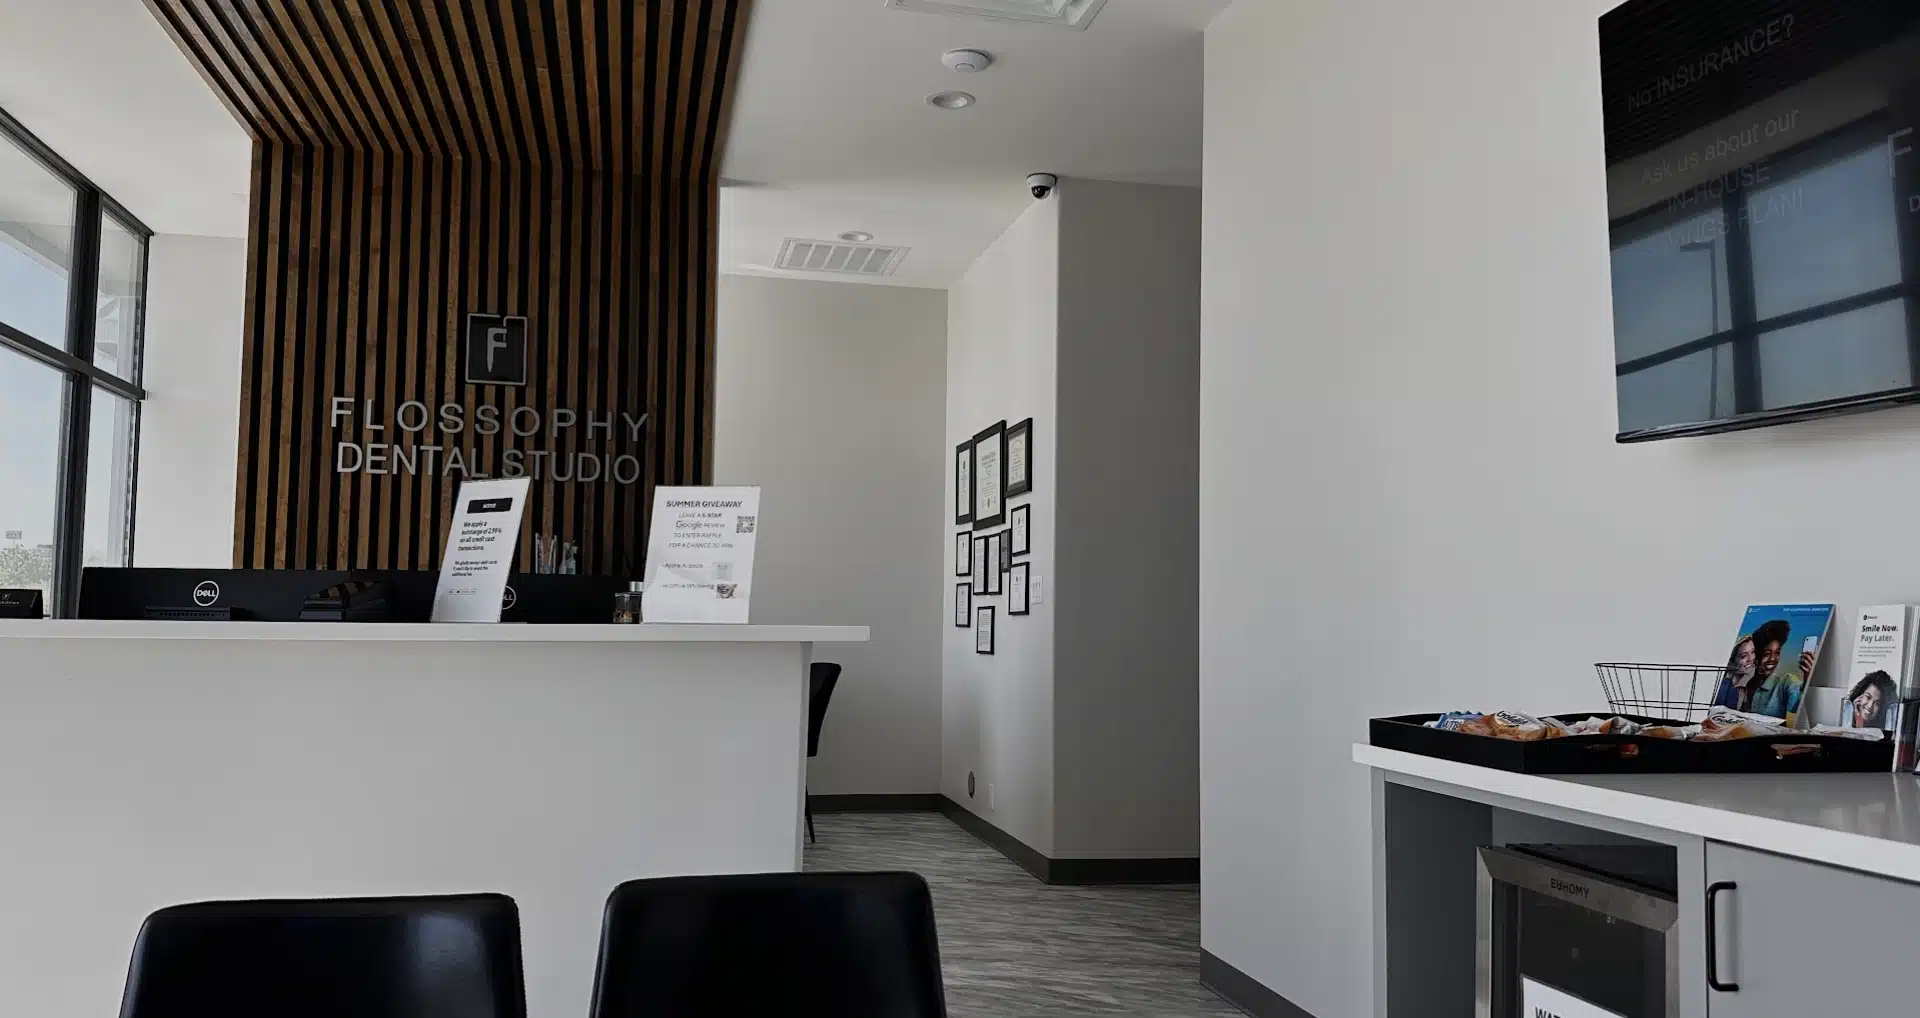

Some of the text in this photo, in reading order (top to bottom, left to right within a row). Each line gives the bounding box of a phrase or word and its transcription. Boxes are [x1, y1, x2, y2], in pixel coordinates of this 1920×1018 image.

[1655, 14, 1796, 100] INSURANCE?
[1641, 109, 1801, 187] Ask us about our
[331, 396, 648, 442] FLOSSOPHY
[337, 441, 640, 485] DENTAL STUDIO
[666, 500, 743, 508] SUMMER GIVEAWAY
[676, 520, 703, 530] Google
[196, 589, 217, 597] DELL
[1861, 624, 1899, 633] Smile Now.
[1860, 634, 1896, 644] Pay Later.
